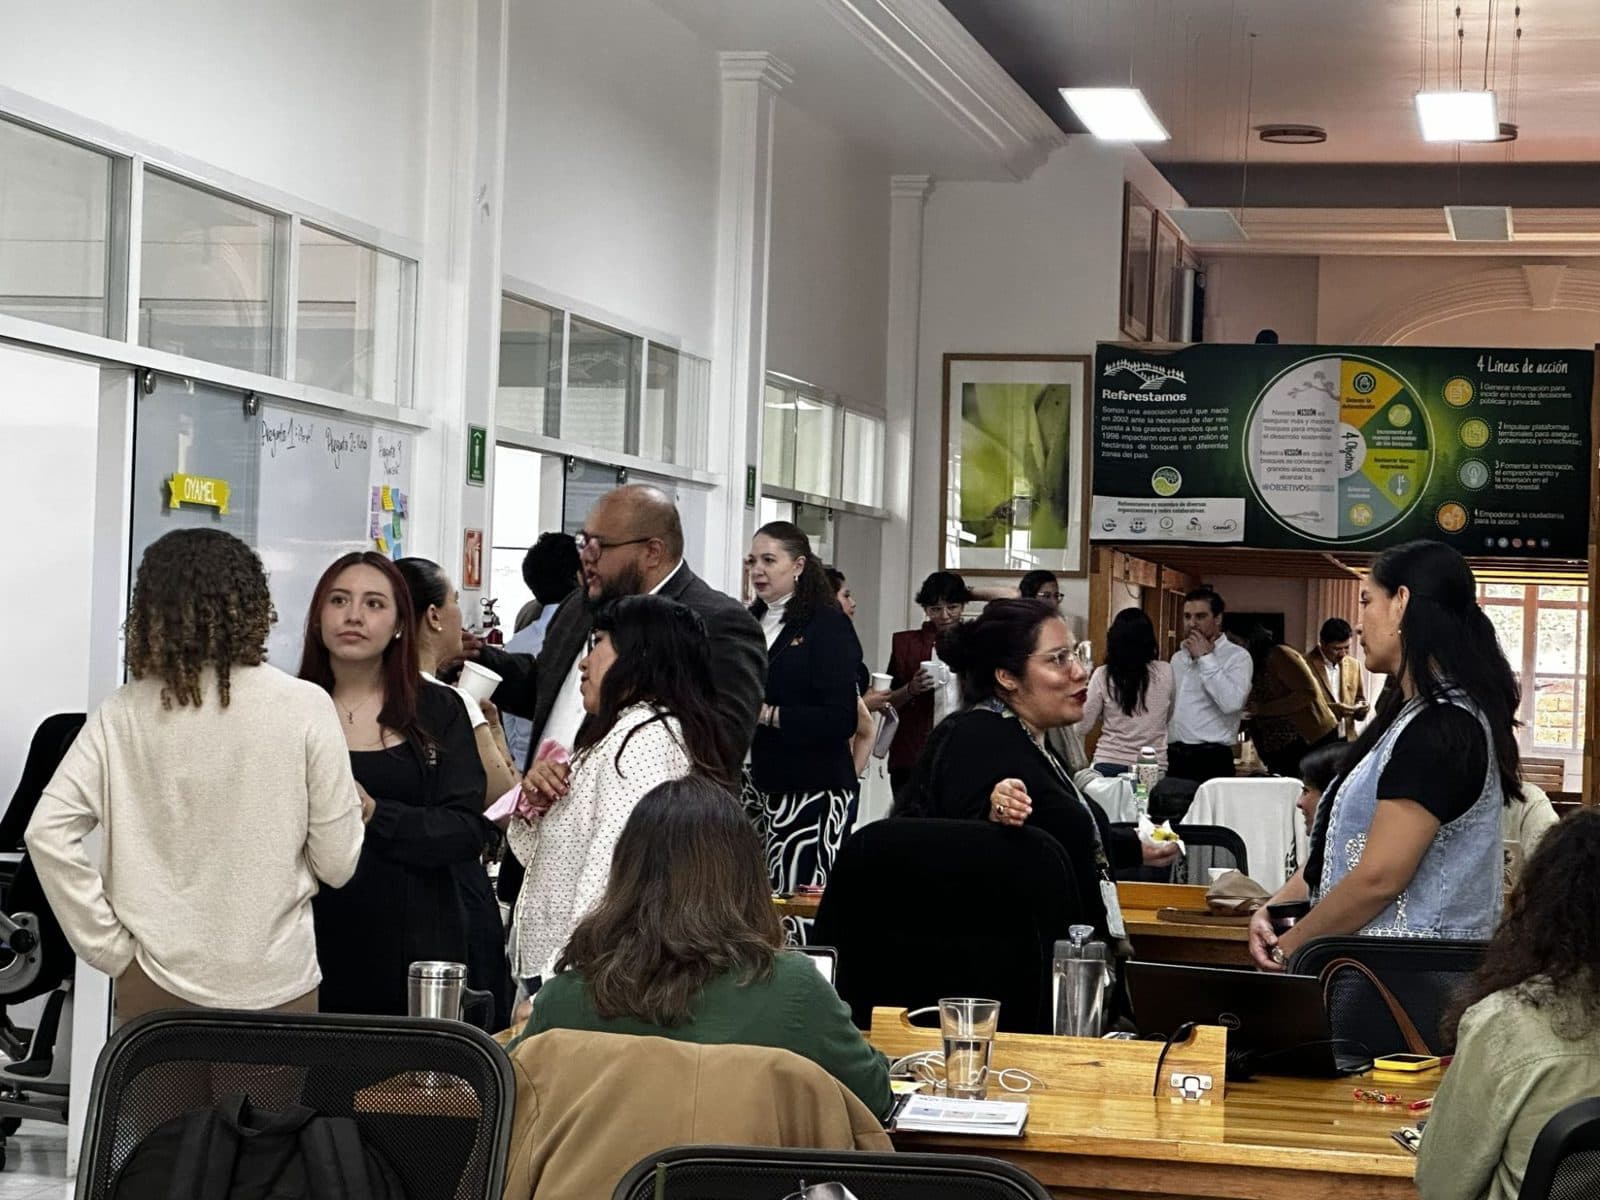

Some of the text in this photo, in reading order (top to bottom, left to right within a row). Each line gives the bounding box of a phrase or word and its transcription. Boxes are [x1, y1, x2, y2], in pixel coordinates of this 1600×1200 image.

[1477, 354, 1568, 374] 4 Líneas de acción
[1102, 389, 1187, 402] Reforestamos
[184, 478, 217, 504] OYAMEL
